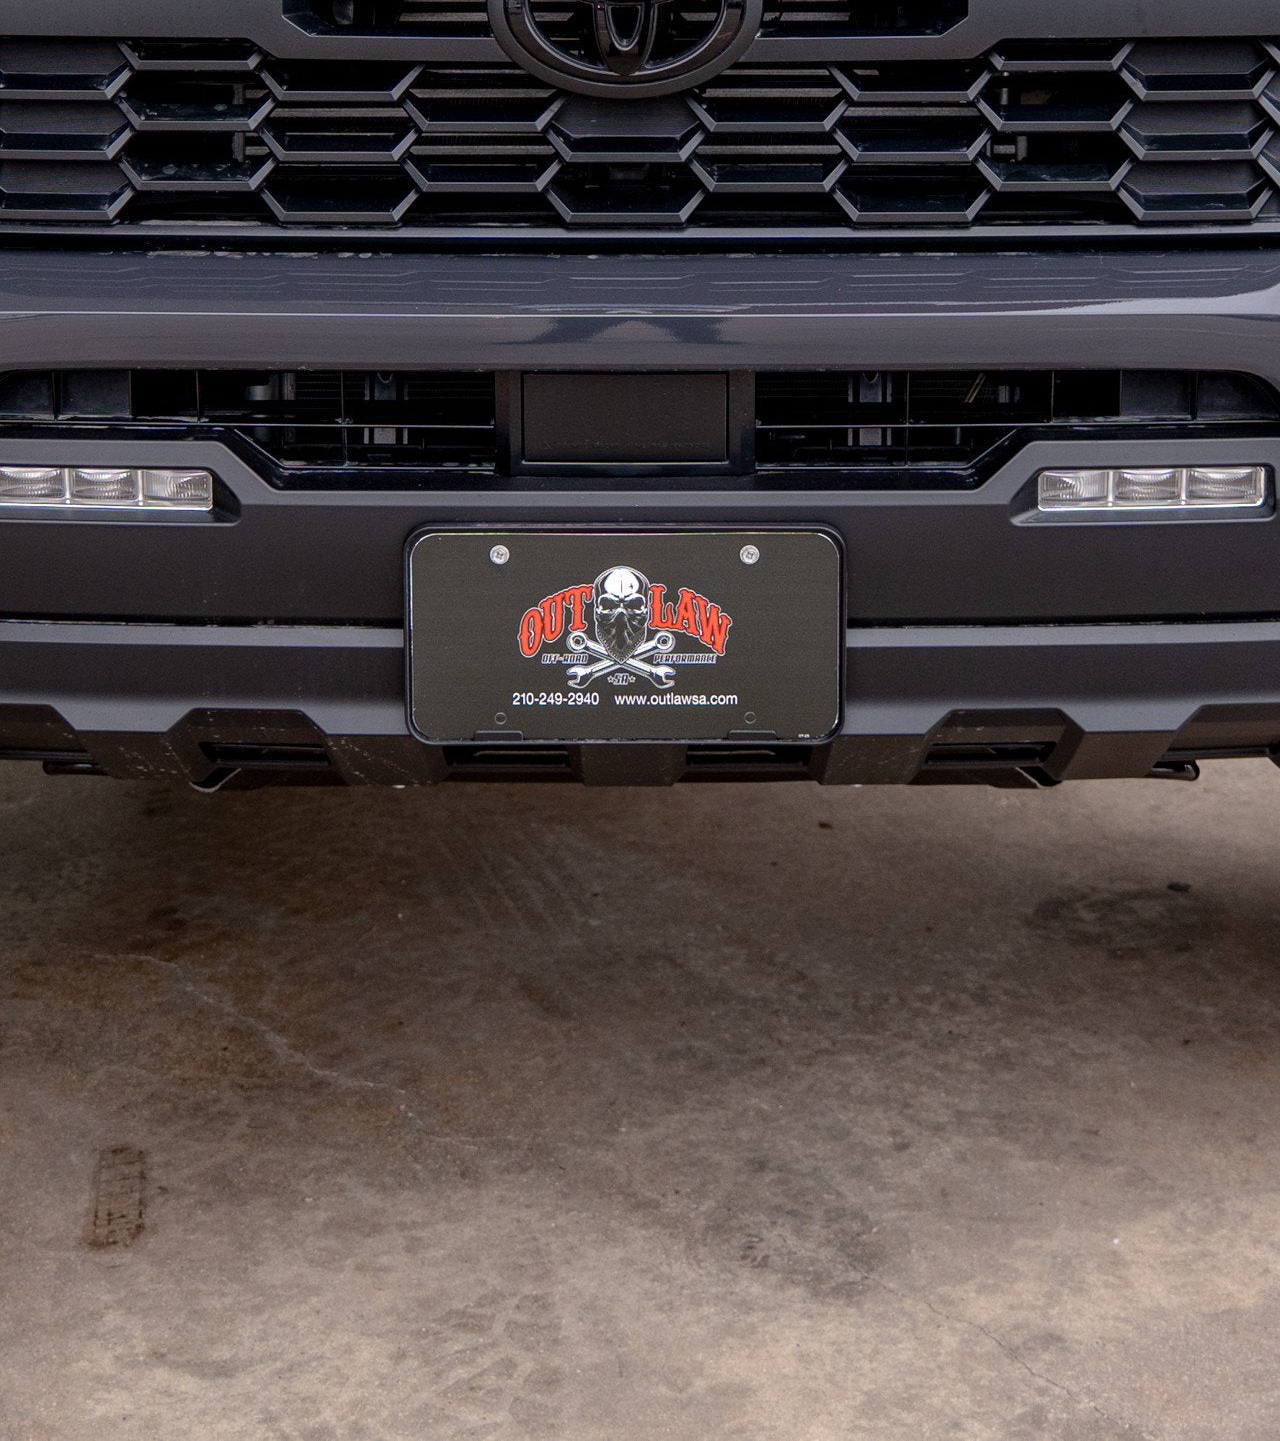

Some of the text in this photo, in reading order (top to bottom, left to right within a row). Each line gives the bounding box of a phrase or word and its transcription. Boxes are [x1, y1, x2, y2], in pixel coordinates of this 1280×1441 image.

[541, 653, 718, 664] OFF-ROAD PERFORMANCE
[613, 673, 630, 686] SA
[512, 692, 738, 706] 210-249-2940 www.outlawsa.com
